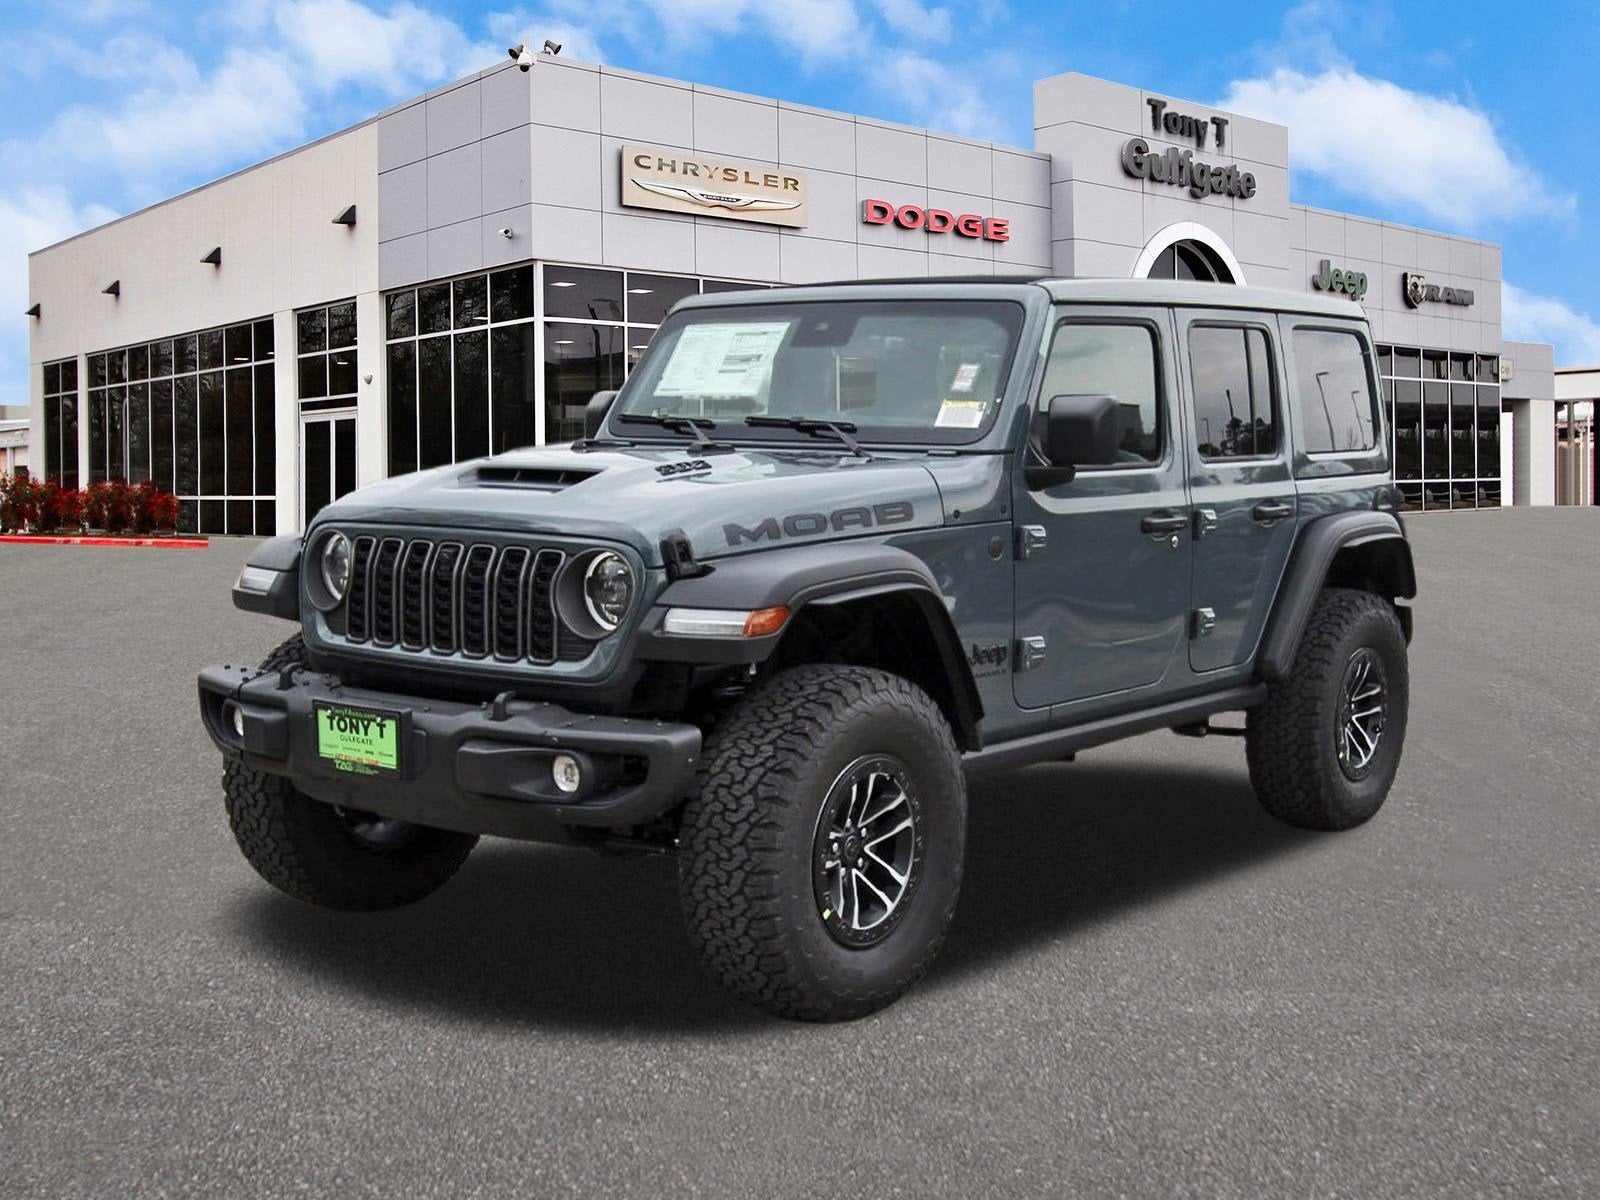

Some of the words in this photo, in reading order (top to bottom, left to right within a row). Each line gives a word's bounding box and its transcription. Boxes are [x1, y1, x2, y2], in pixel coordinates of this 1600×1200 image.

[1147, 98, 1208, 147] Tony
[1210, 116, 1229, 147] T
[634, 154, 801, 193] CHRYSLER
[1121, 138, 1256, 198] Gulfgate
[862, 198, 1010, 242] DODGE
[1313, 259, 1368, 300] Jeep
[1423, 286, 1474, 306] RAM
[722, 501, 915, 546] MOAB
[968, 643, 1007, 667] Jeep
[326, 714, 371, 736] TONY
[376, 720, 386, 739] T
